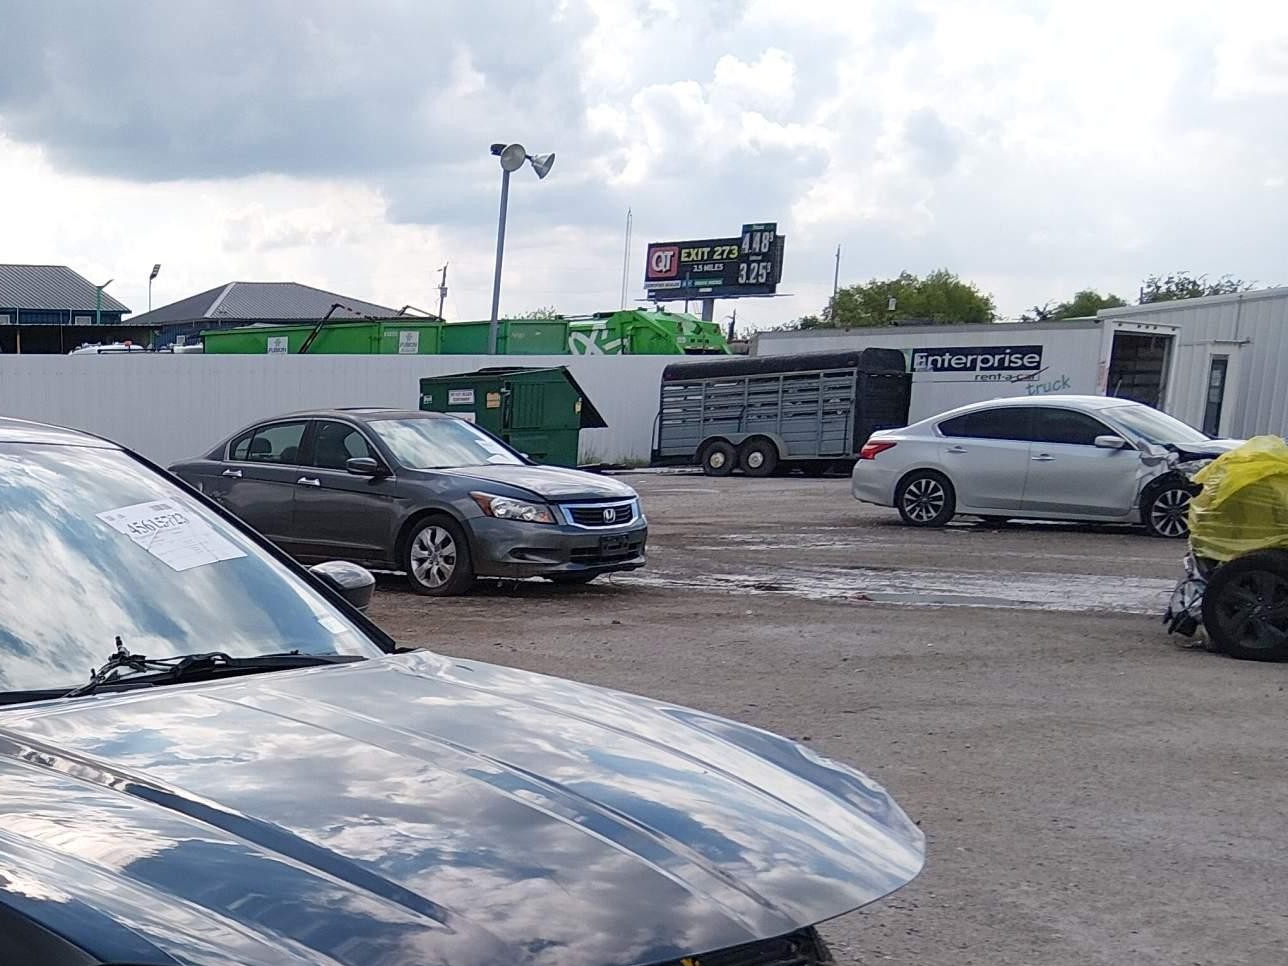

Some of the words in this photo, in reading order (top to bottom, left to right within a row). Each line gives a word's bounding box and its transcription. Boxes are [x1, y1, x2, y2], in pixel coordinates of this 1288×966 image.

[652, 251, 674, 272] QT
[680, 247, 711, 262] EXIT
[713, 245, 739, 260] 273
[704, 263, 724, 272] MILES
[914, 349, 1040, 371] Enterprise
[1026, 375, 1071, 396] truck
[127, 512, 190, 535] 45615723
